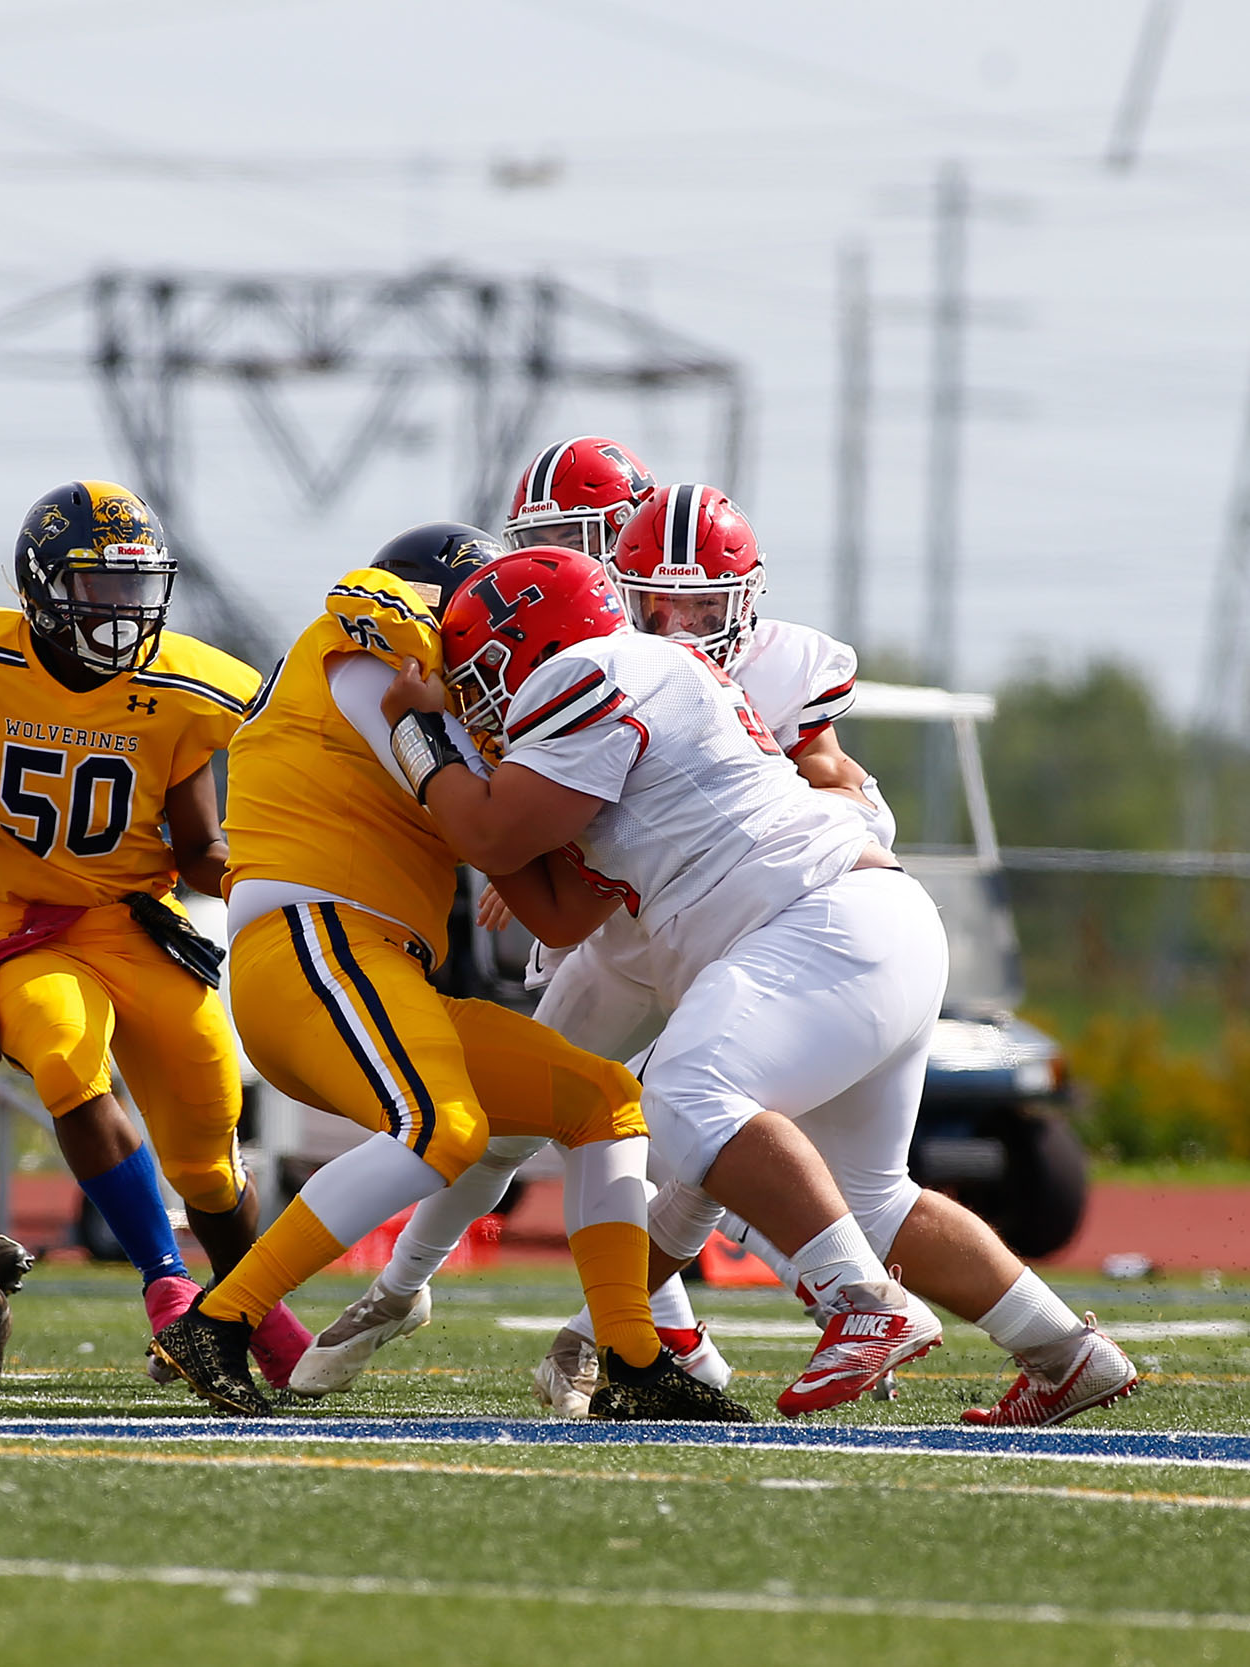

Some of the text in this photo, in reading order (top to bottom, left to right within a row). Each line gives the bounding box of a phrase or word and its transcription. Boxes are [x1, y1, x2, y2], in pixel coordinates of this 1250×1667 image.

[598, 445, 658, 498] L
[521, 502, 553, 515] Riddell
[118, 546, 145, 556] Riddell
[658, 566, 699, 576] Riddell
[468, 571, 544, 631] L
[6, 717, 139, 752] WOLVERINES
[840, 1313, 893, 1338] NIKE
